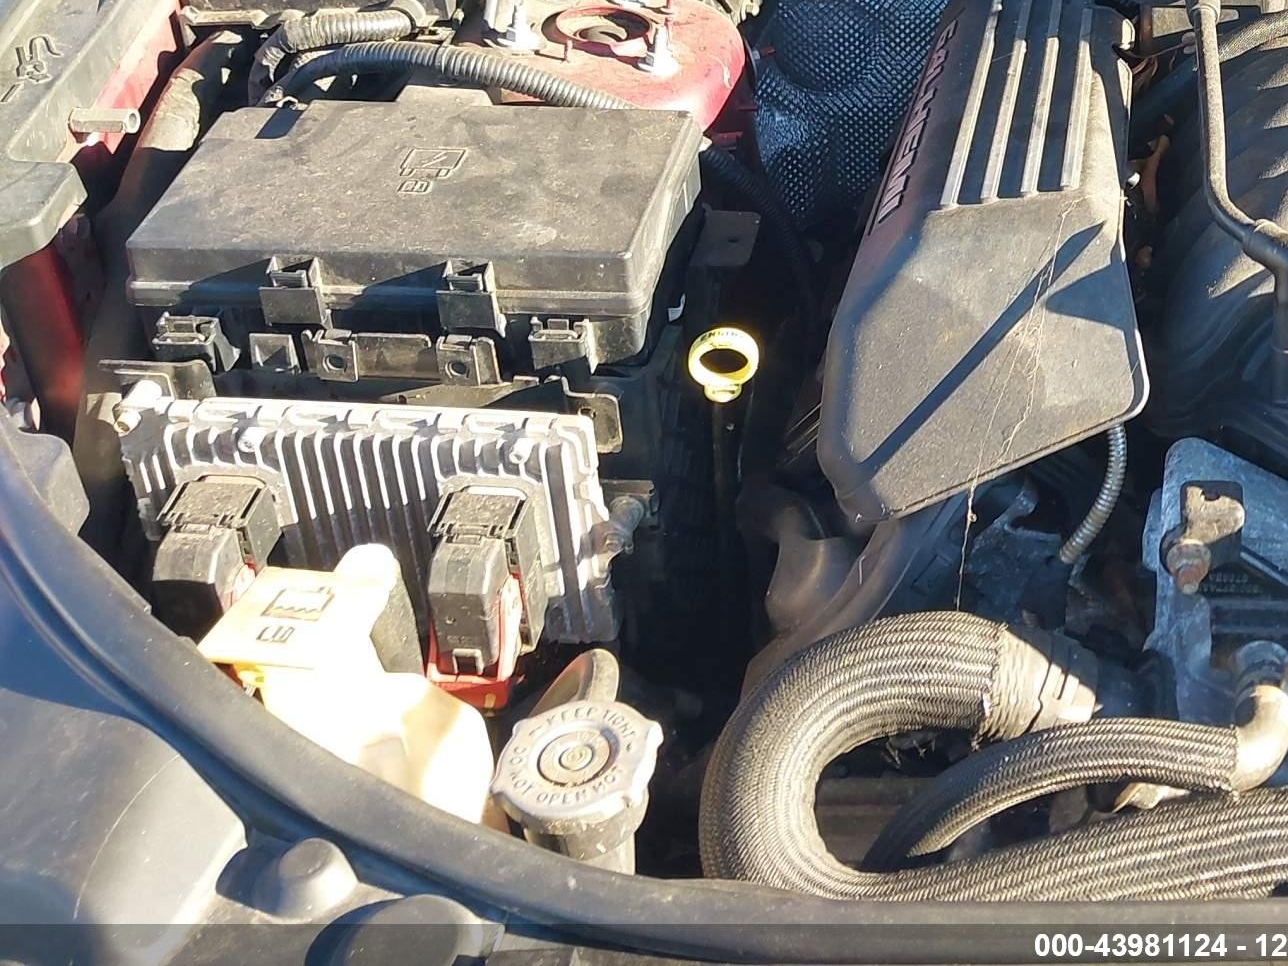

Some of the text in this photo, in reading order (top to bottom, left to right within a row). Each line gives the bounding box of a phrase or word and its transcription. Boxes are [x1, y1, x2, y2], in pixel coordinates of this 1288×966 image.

[876, 87, 937, 224] HEMI
[545, 706, 597, 729] KEEP
[510, 769, 533, 796] NOT
[536, 787, 588, 807] OPEN
